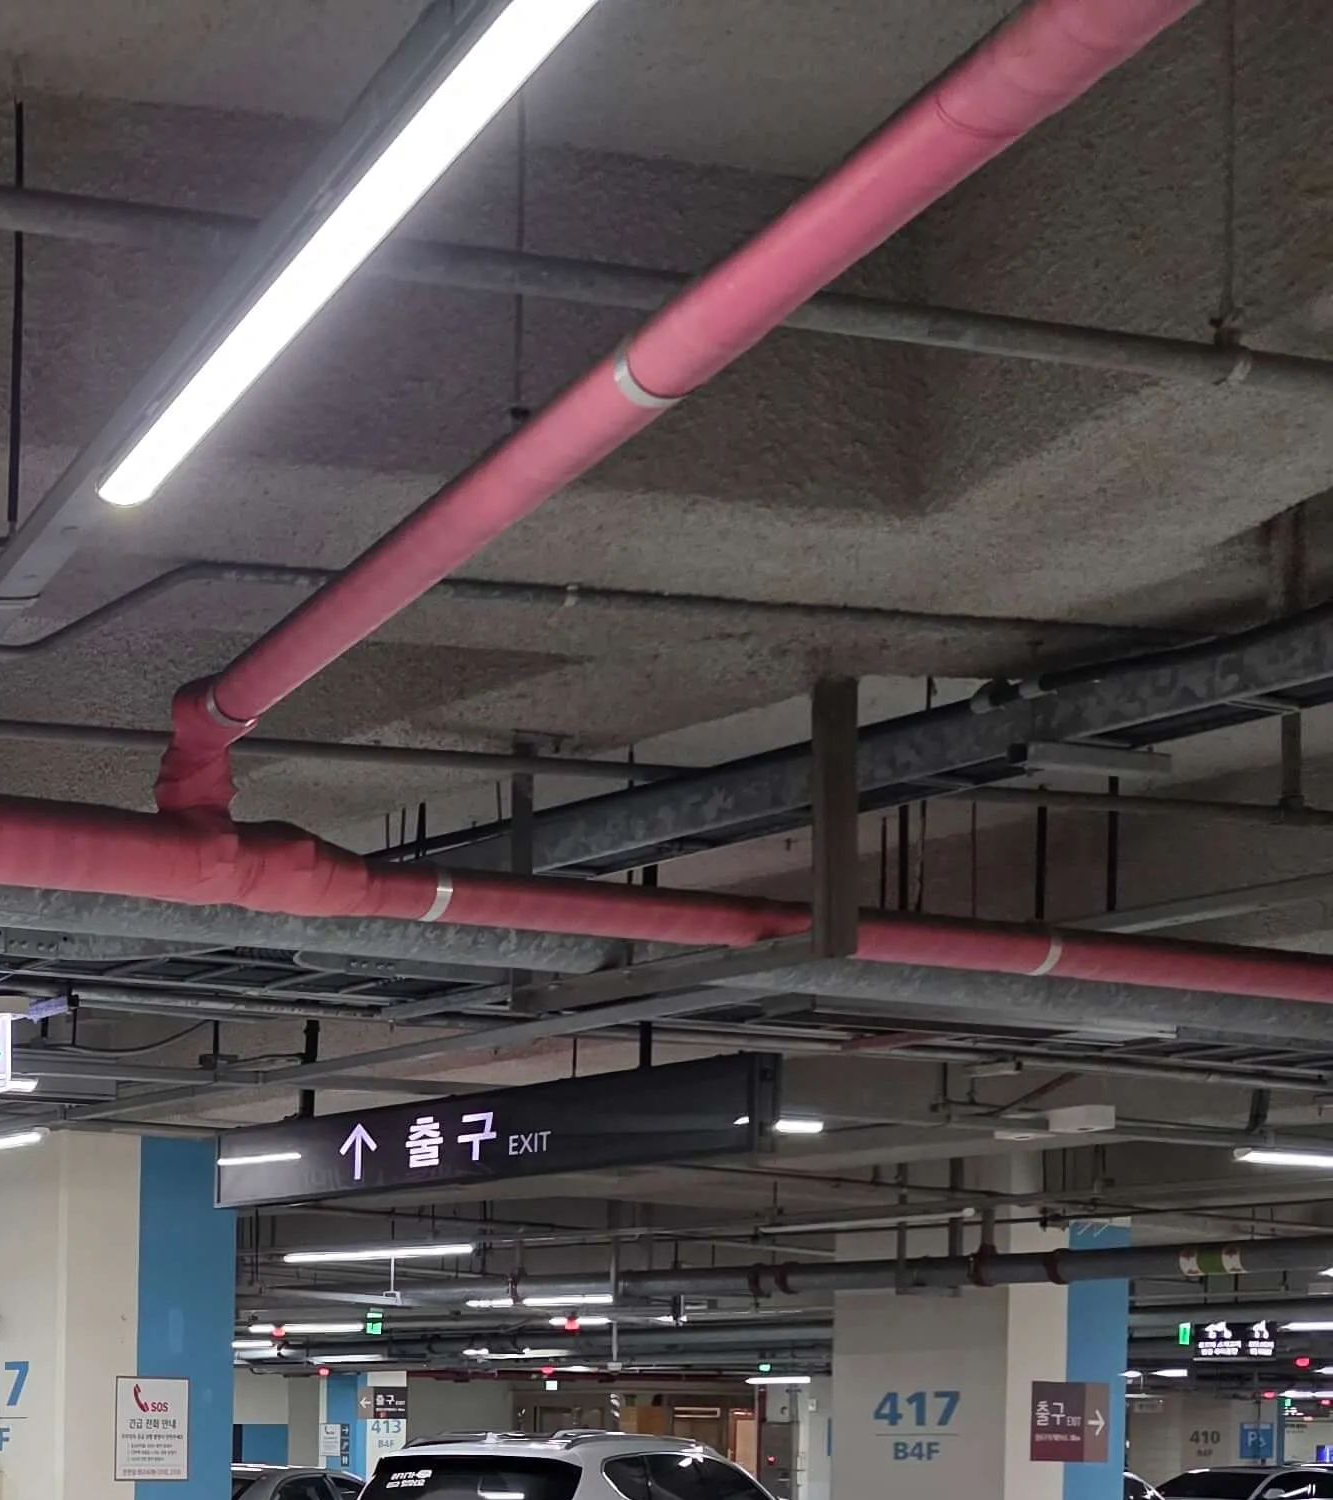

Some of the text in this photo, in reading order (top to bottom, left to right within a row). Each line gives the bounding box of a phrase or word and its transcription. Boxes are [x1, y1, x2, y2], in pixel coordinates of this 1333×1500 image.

[508, 1131, 551, 1156] EXIT
[151, 1402, 169, 1412] SOS
[874, 1391, 961, 1426] 417
[1035, 1400, 1066, 1426] 출구
[162, 1419, 177, 1429] 안내
[371, 1420, 401, 1434] 413
[1190, 1430, 1221, 1444] 410
[893, 1442, 940, 1460] B4F
